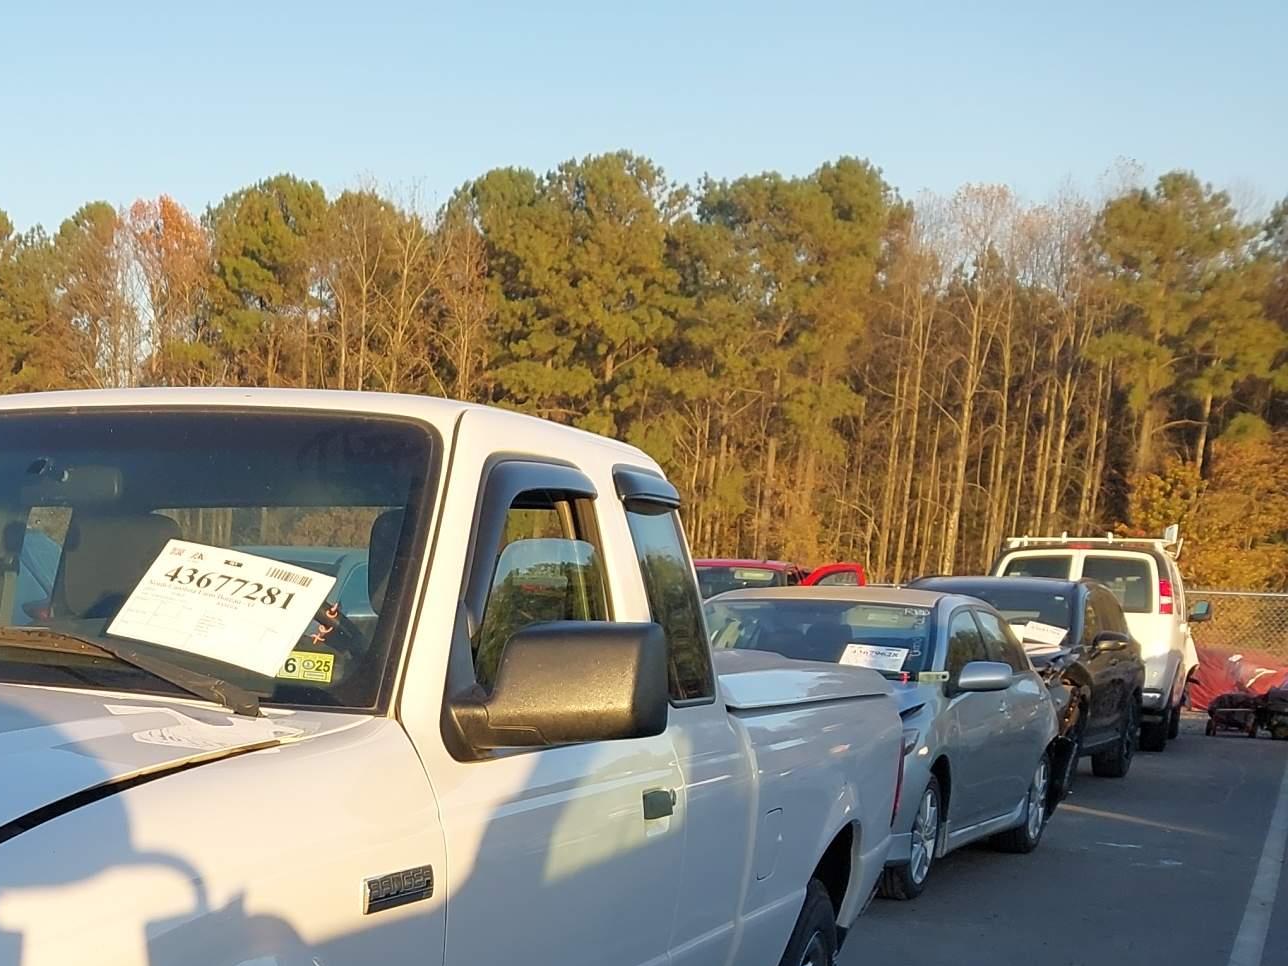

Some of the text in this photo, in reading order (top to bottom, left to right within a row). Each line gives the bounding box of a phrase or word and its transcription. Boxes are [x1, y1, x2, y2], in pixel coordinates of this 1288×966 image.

[164, 565, 296, 610] 43677281
[284, 657, 331, 673] 6 25
